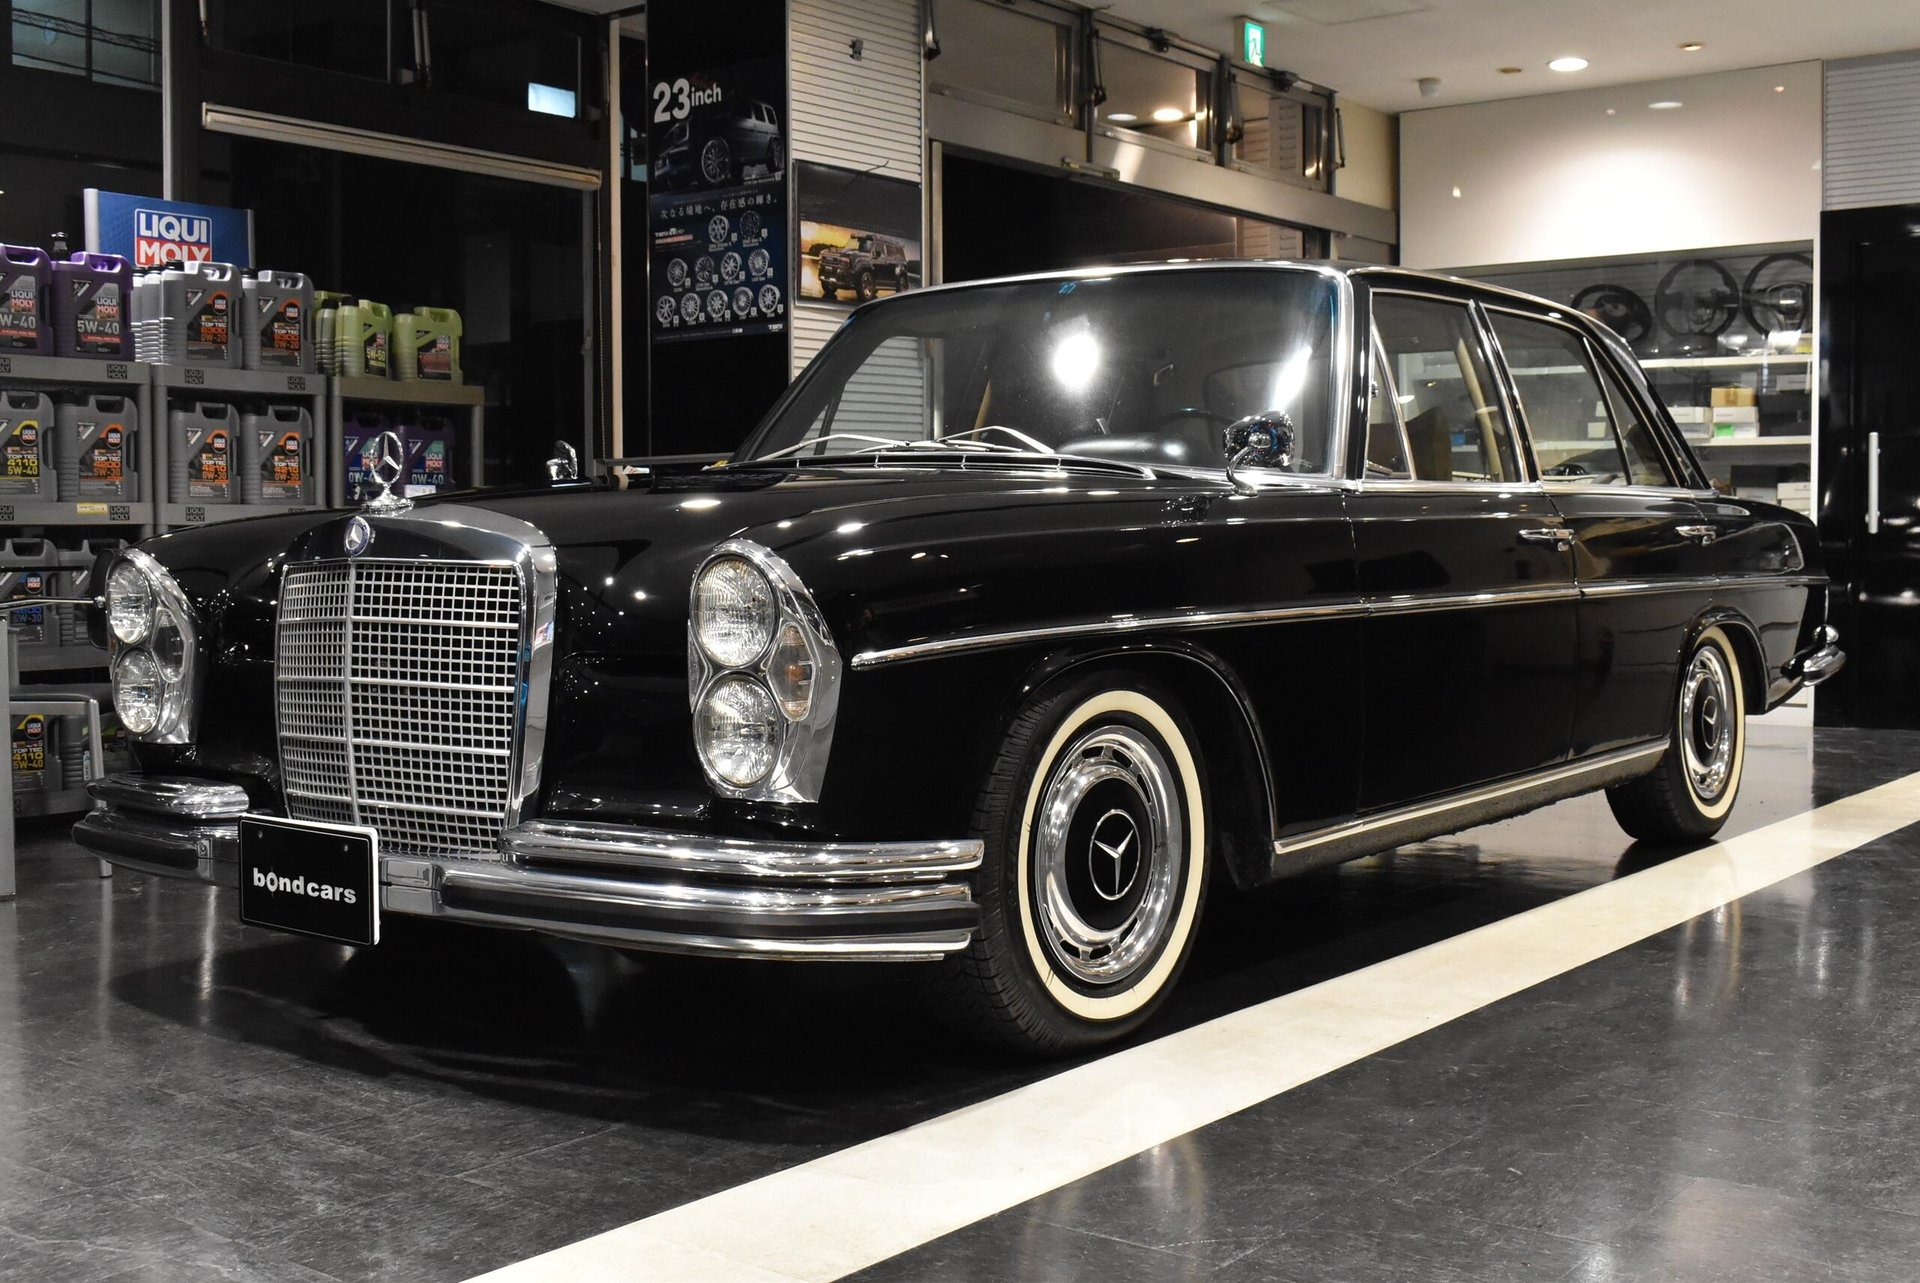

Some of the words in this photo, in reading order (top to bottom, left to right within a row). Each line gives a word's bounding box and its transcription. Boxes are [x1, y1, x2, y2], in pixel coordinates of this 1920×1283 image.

[140, 212, 207, 243] LIQUI
[140, 240, 209, 265] MOLY
[11, 290, 34, 299] LIQUI
[12, 298, 34, 307] MOLY
[96, 297, 118, 305] LIQUI
[97, 305, 119, 313] MOLY
[0, 314, 36, 329] W-40
[77, 321, 119, 334] 5W-40
[7, 466, 38, 475] 5W-40
[94, 468, 121, 476] 5W-30
[412, 473, 445, 485] 0W-40
[13, 752, 43, 761] 4110
[13, 760, 44, 769] 5W-40
